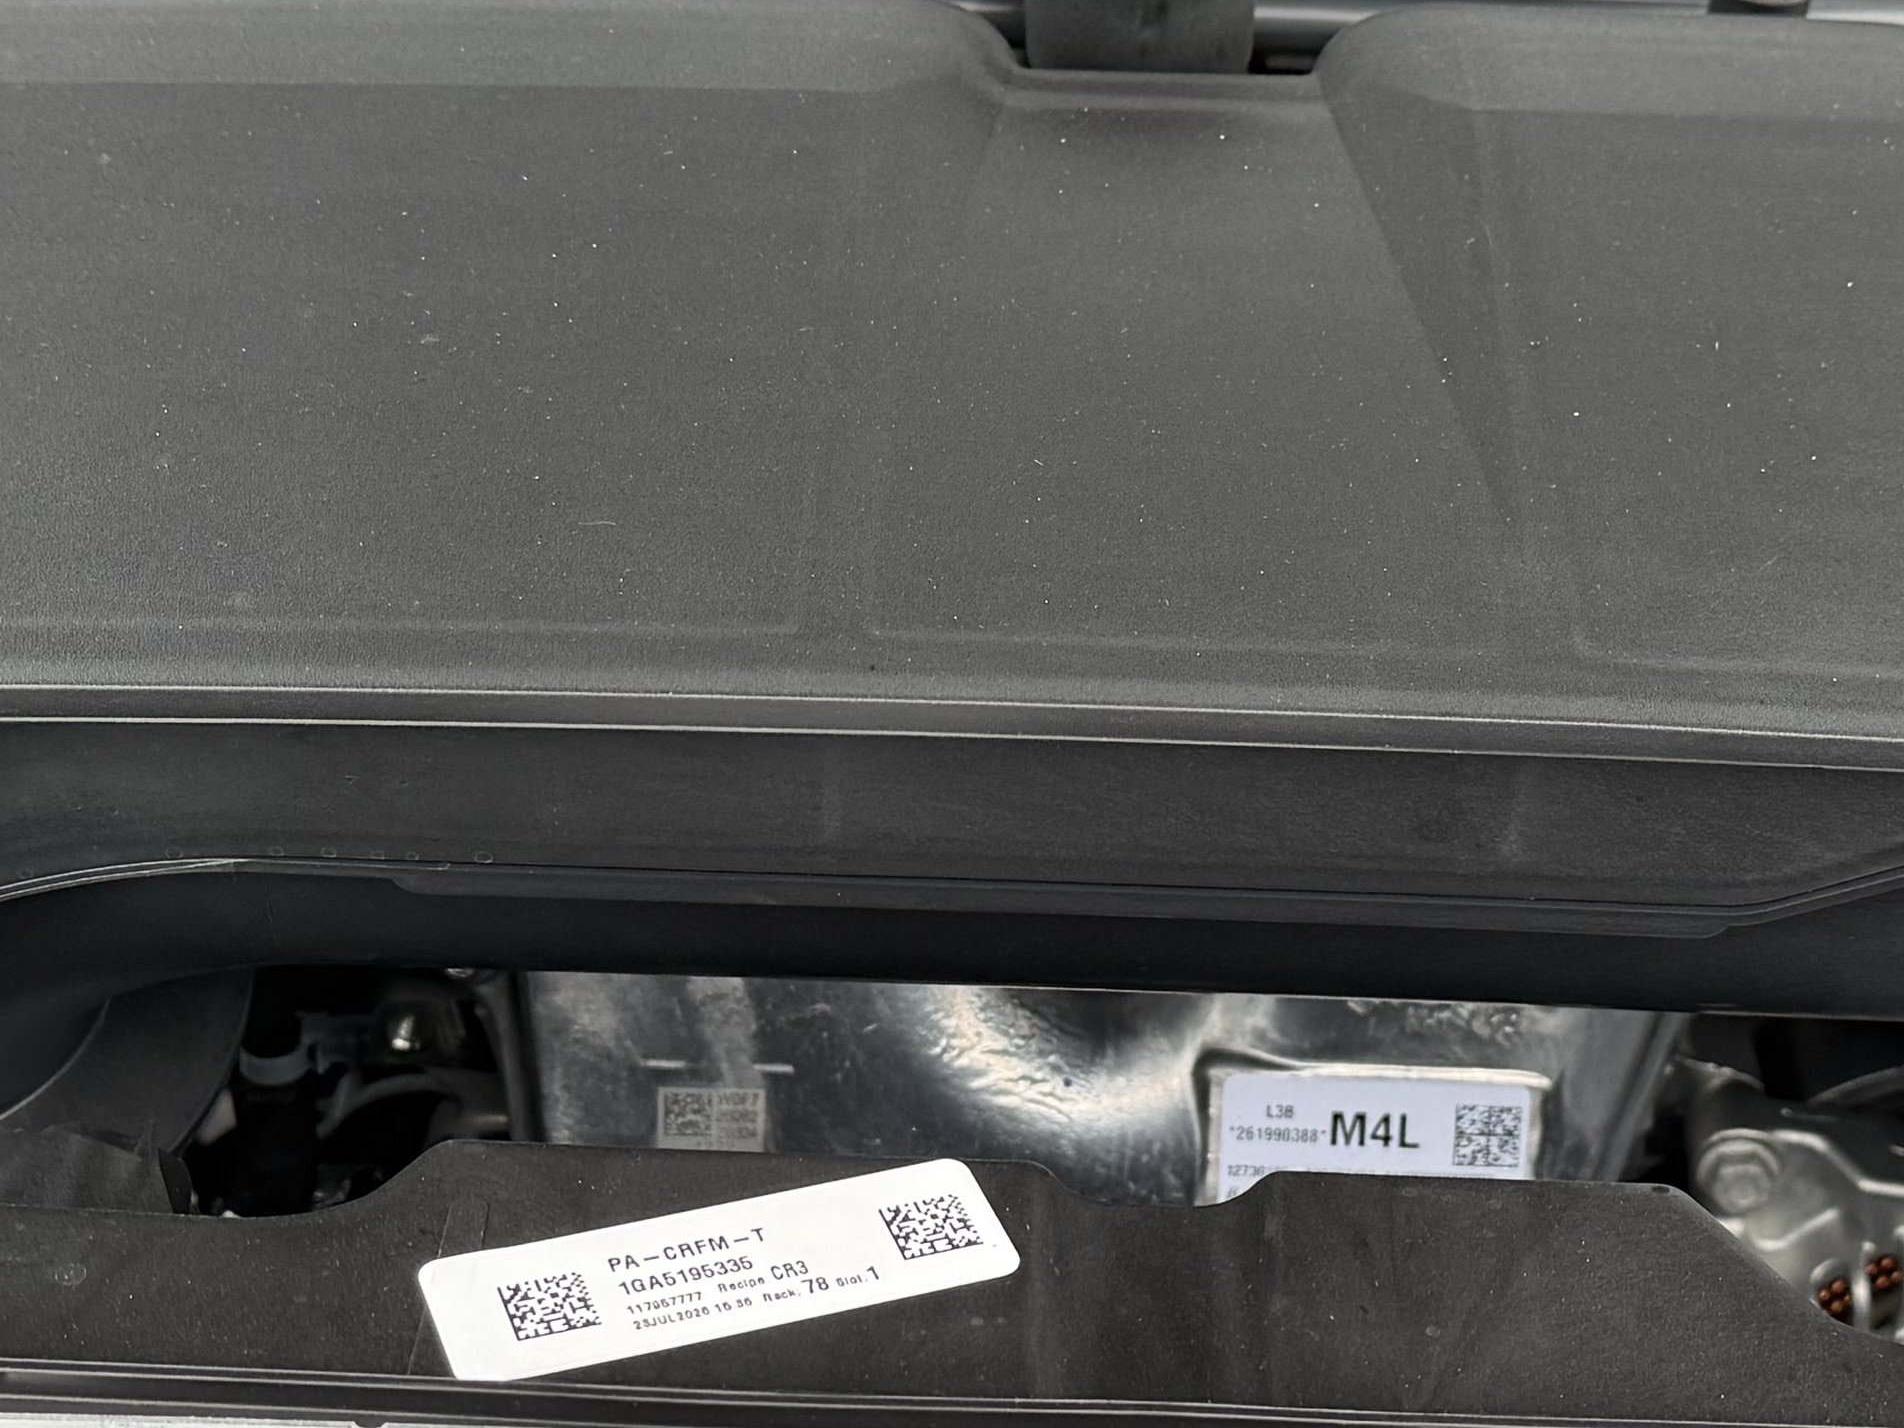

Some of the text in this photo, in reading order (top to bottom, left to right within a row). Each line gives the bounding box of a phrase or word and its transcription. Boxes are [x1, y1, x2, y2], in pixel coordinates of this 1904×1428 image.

[1330, 1111, 1420, 1148] M4L
[771, 1260, 809, 1281] CR3
[801, 1277, 829, 1294] 78
[867, 1266, 880, 1281] 1
